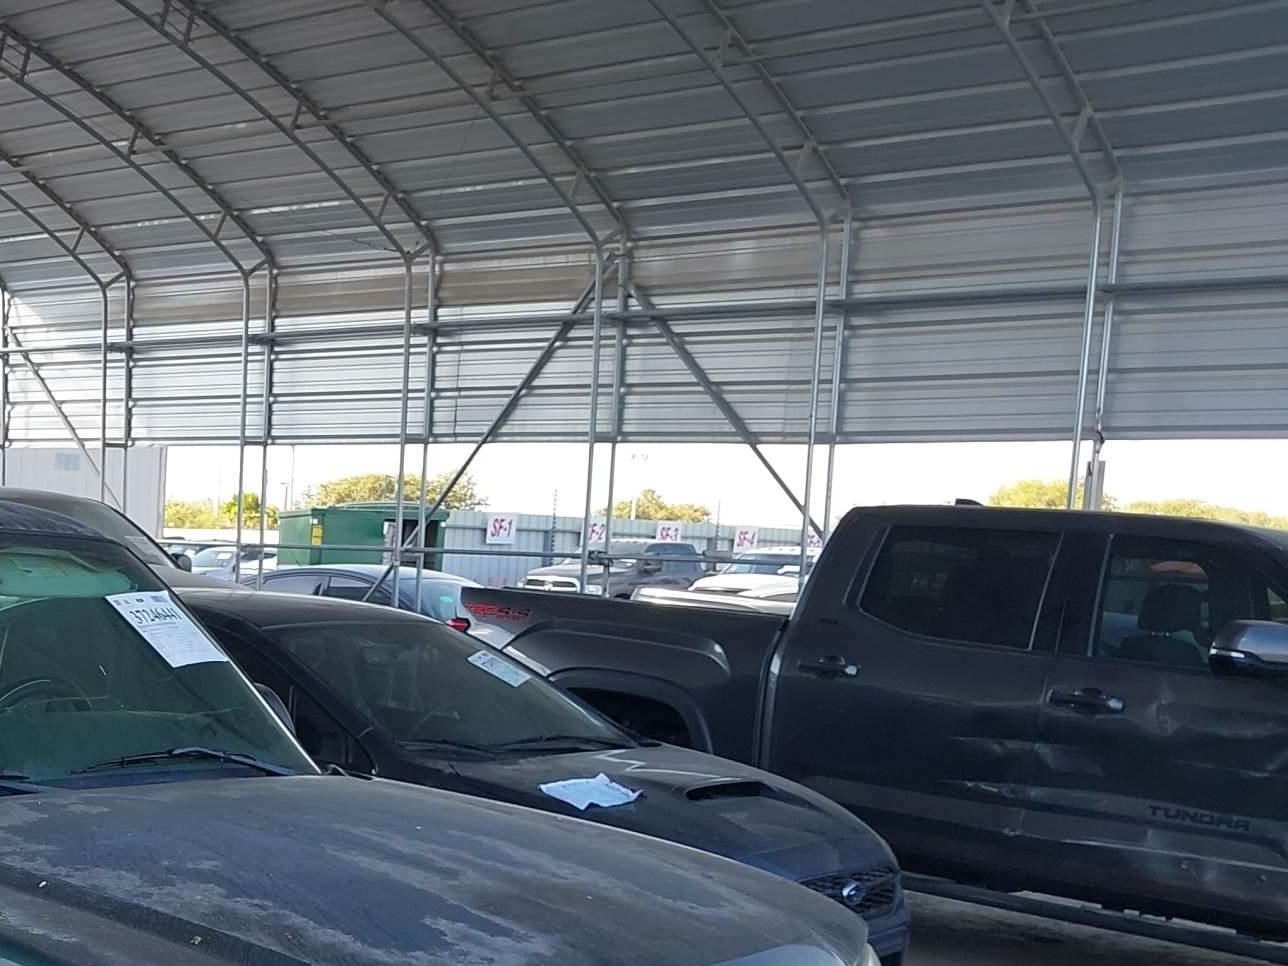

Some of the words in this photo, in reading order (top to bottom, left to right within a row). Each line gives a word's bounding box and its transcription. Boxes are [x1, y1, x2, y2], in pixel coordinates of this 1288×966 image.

[490, 518, 513, 537] SF-1
[129, 607, 183, 624] 37246441
[1149, 805, 1251, 831] TUNDRA
